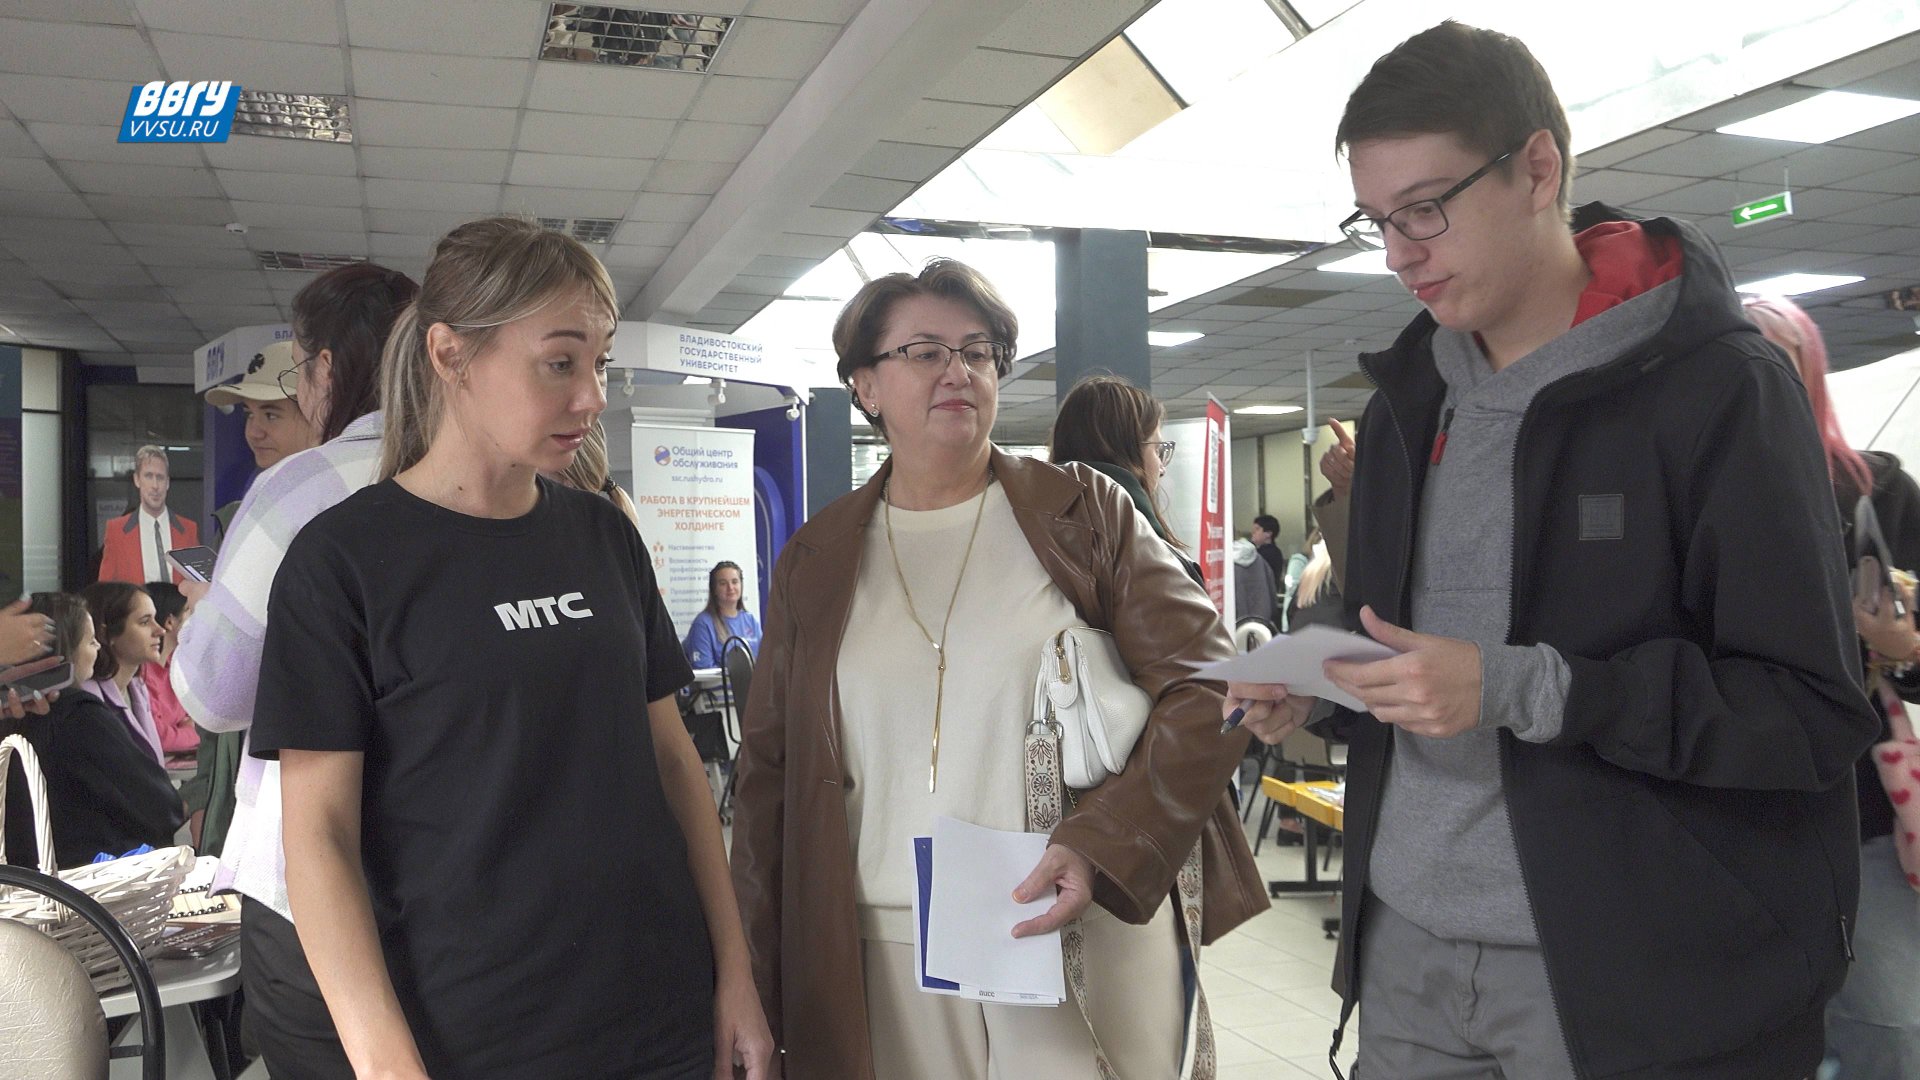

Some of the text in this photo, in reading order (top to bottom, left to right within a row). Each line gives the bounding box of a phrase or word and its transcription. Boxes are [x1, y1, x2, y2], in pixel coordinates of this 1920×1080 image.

[679, 334, 763, 353] ВЛАДИВОСТОКСКИЙ
[679, 346, 762, 364] ГОСУДАРСТВЕННЫЙ
[680, 358, 738, 374] УНИВЕРСИТЕТ
[672, 446, 733, 459] Общий центр
[673, 458, 738, 470] обслуживания
[672, 474, 723, 484] ssc.rushydro.ru
[640, 495, 750, 505] РАБОТА В КРУПНЕЙШЕМ
[657, 508, 741, 519] ЭНЕРГЕТИЧЕСКОМ
[675, 521, 725, 532] ХОЛДИНГЕ
[493, 592, 593, 631] МТС
